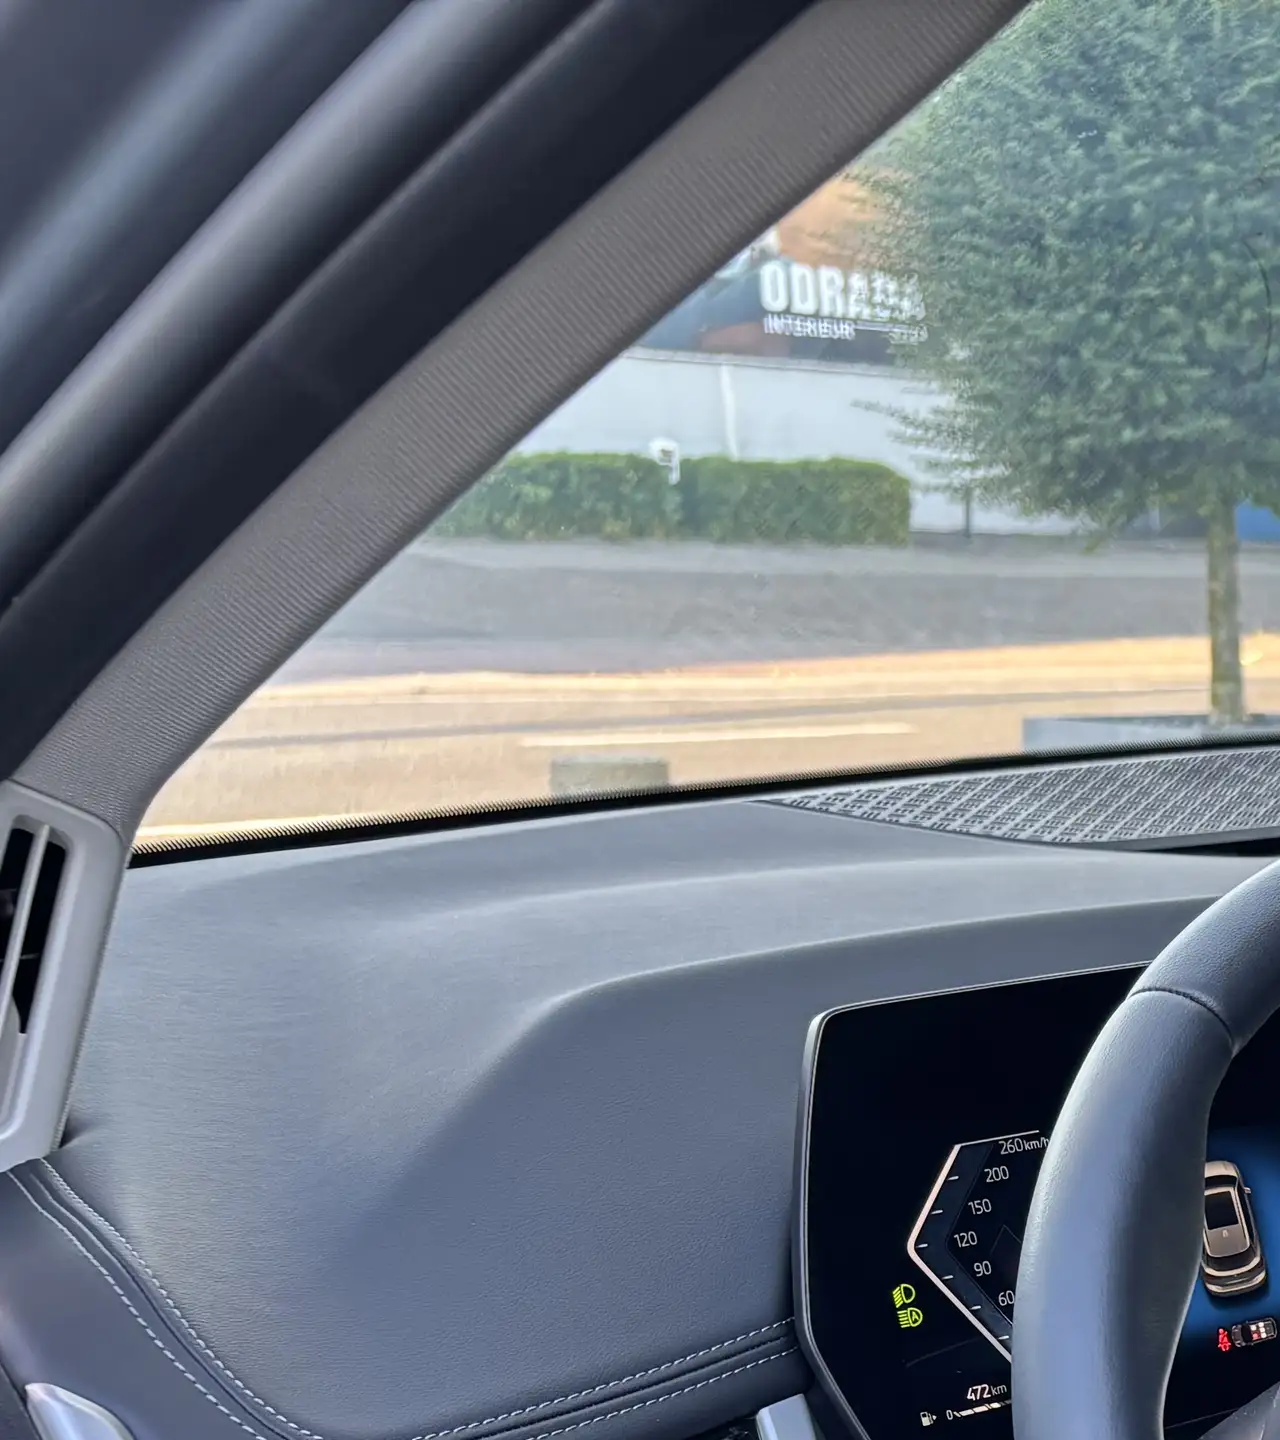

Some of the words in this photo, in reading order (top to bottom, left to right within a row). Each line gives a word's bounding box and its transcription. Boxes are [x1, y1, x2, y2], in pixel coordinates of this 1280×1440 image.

[984, 1165, 1010, 1183] 200
[968, 1198, 992, 1215] 150
[953, 1230, 978, 1248] 120
[973, 1260, 992, 1277] 90
[998, 1290, 1015, 1306] 60
